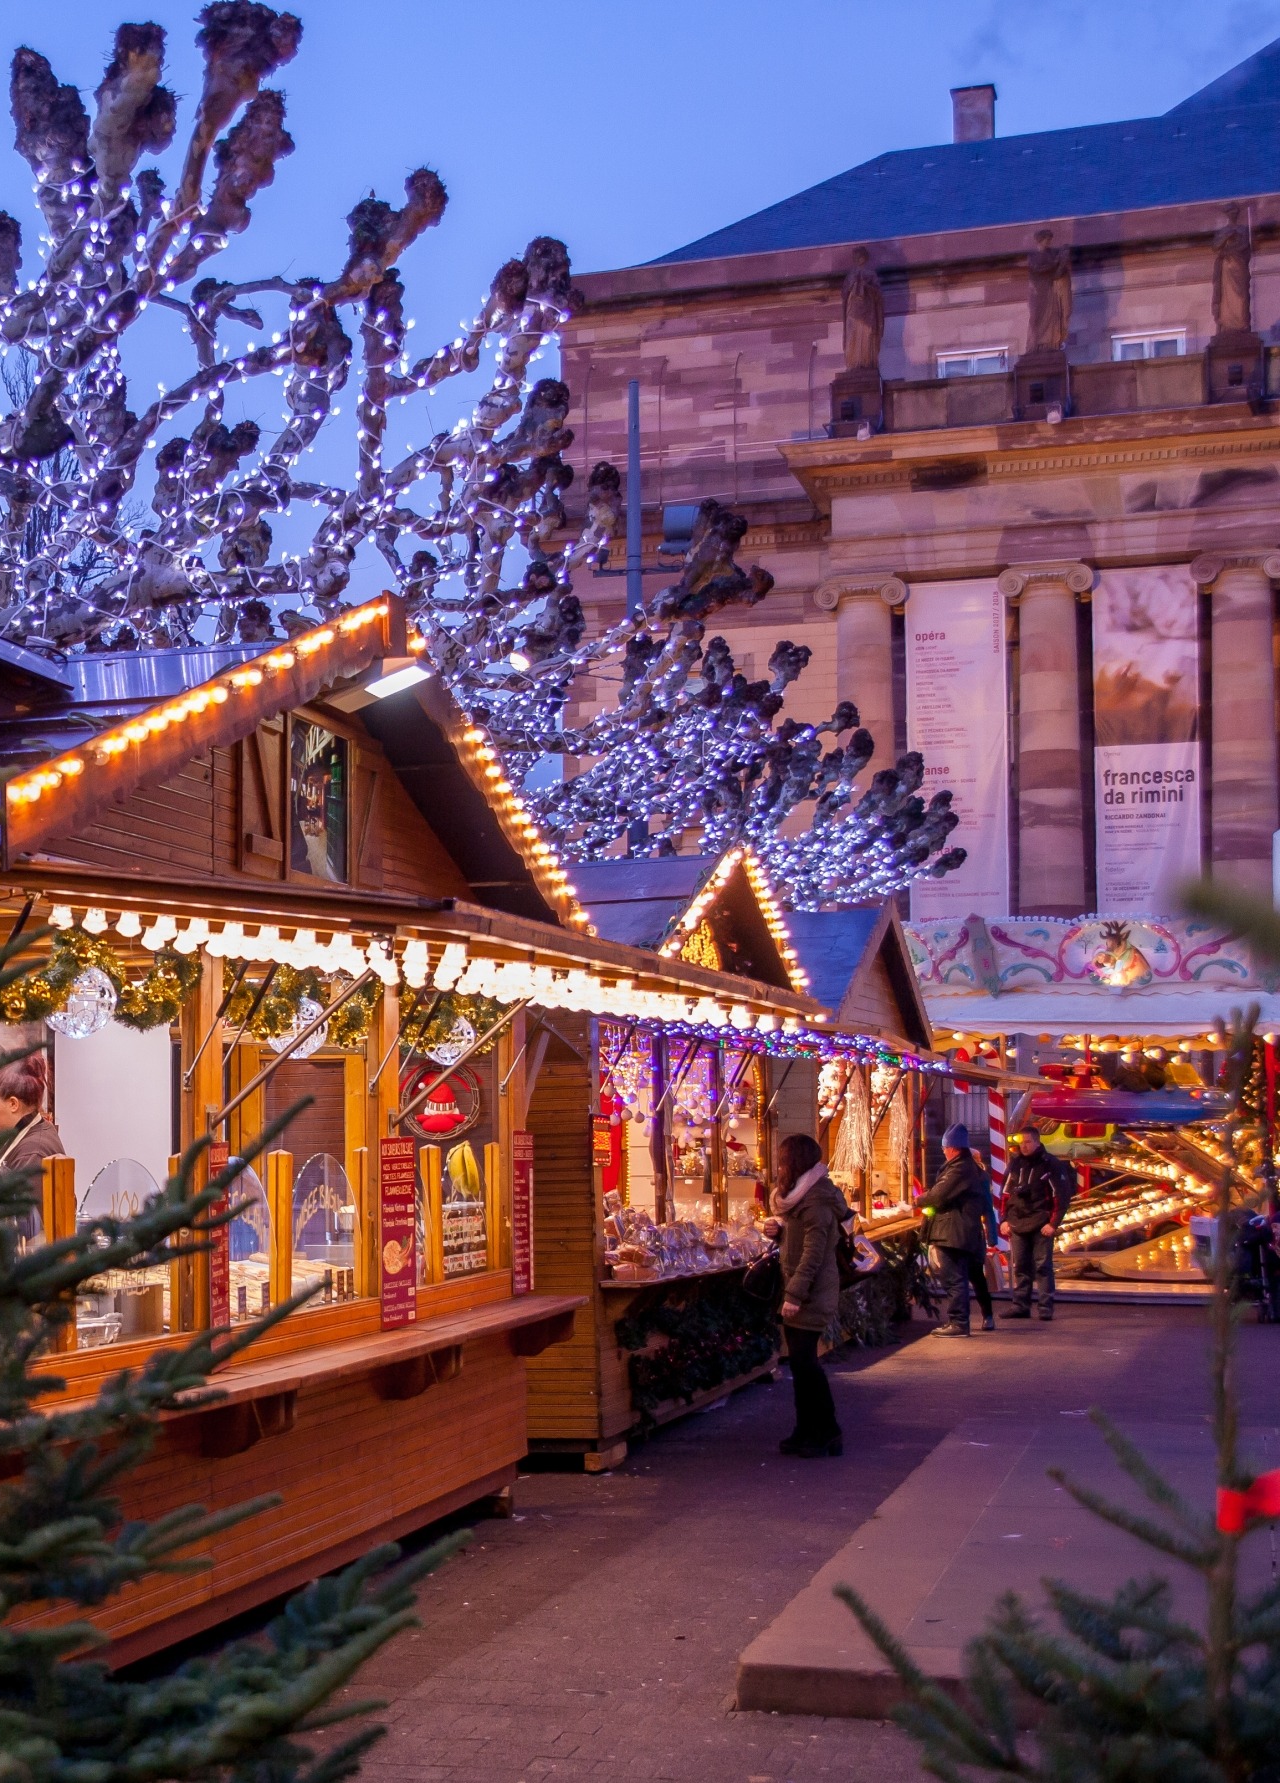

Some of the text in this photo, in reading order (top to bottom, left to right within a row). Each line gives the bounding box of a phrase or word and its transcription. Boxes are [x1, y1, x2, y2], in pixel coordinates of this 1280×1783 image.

[915, 631, 946, 642] opéra
[924, 766, 950, 775] anse
[1103, 769, 1195, 786] francesca
[1103, 785, 1184, 805] da rimini
[1104, 813, 1134, 821] RICCARDO
